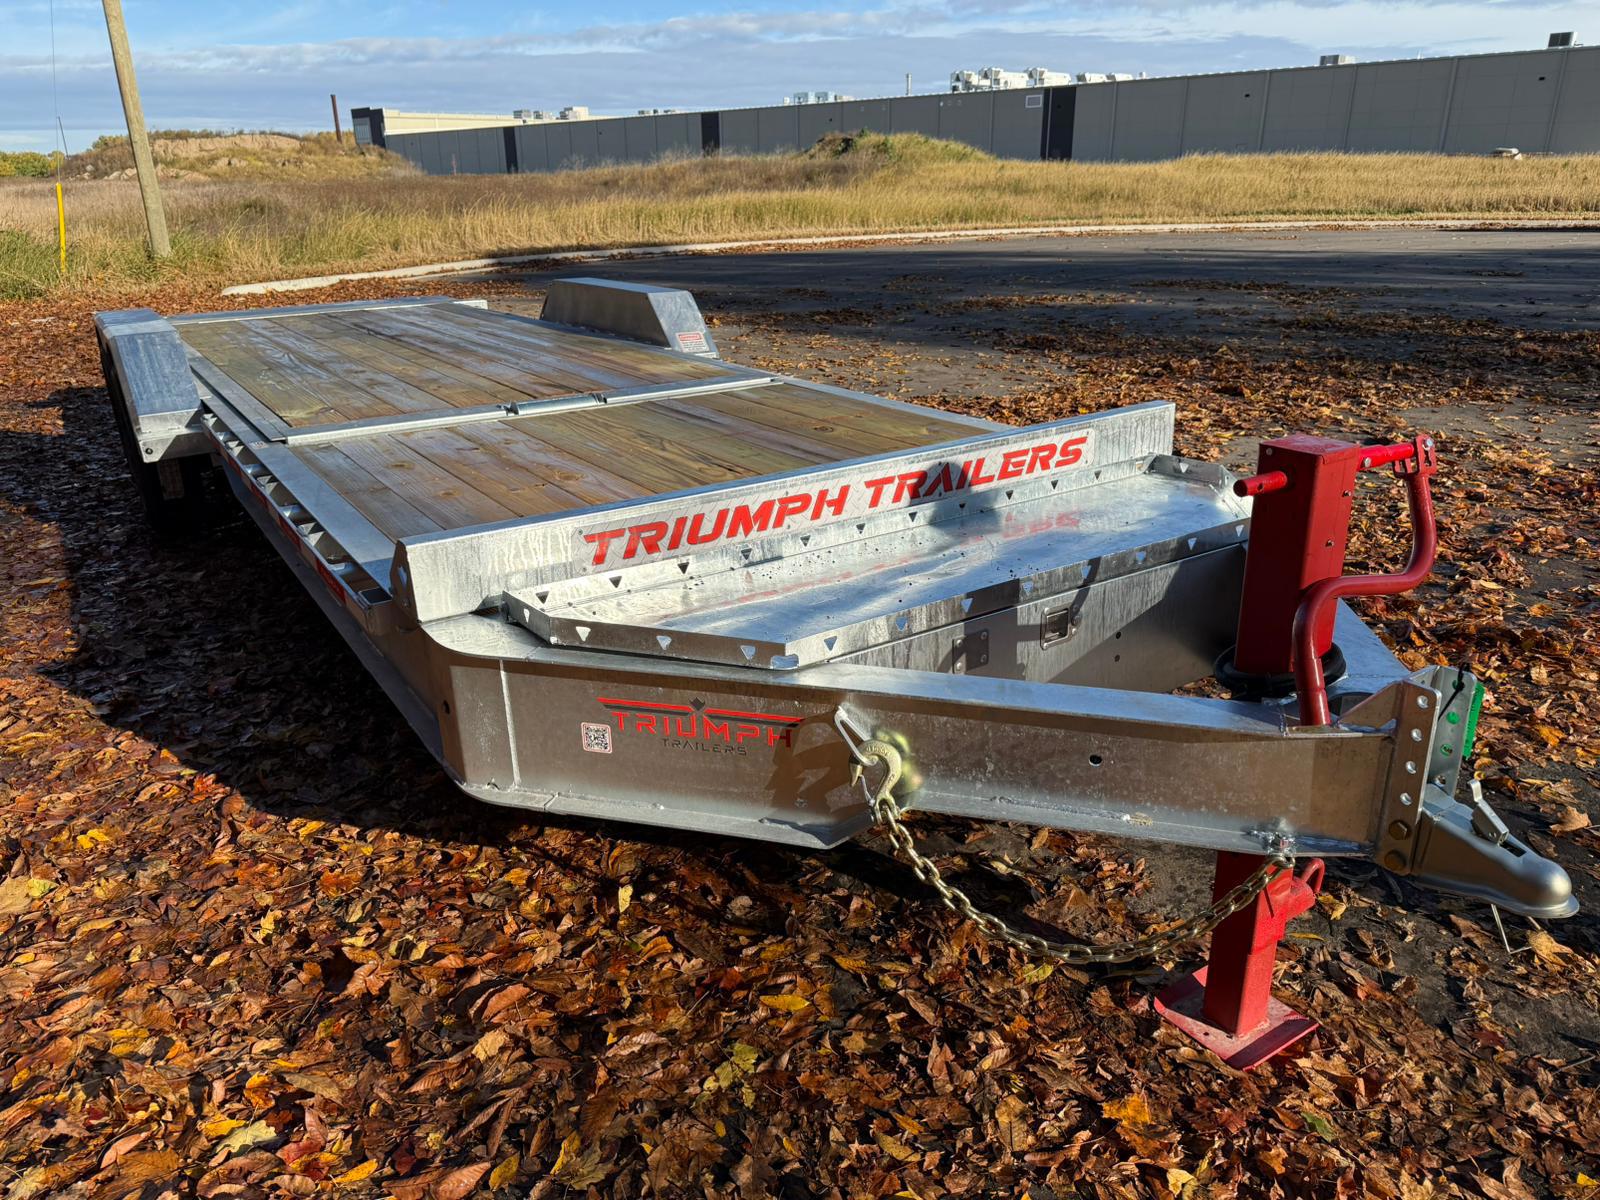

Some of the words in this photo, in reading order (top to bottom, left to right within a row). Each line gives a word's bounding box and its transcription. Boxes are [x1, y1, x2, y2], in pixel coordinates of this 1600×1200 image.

[583, 485, 851, 567] TRIUMPH
[864, 436, 1088, 509] TRAILERS
[612, 711, 792, 748] TRIUMPH
[661, 738, 747, 757] TRAILERS
